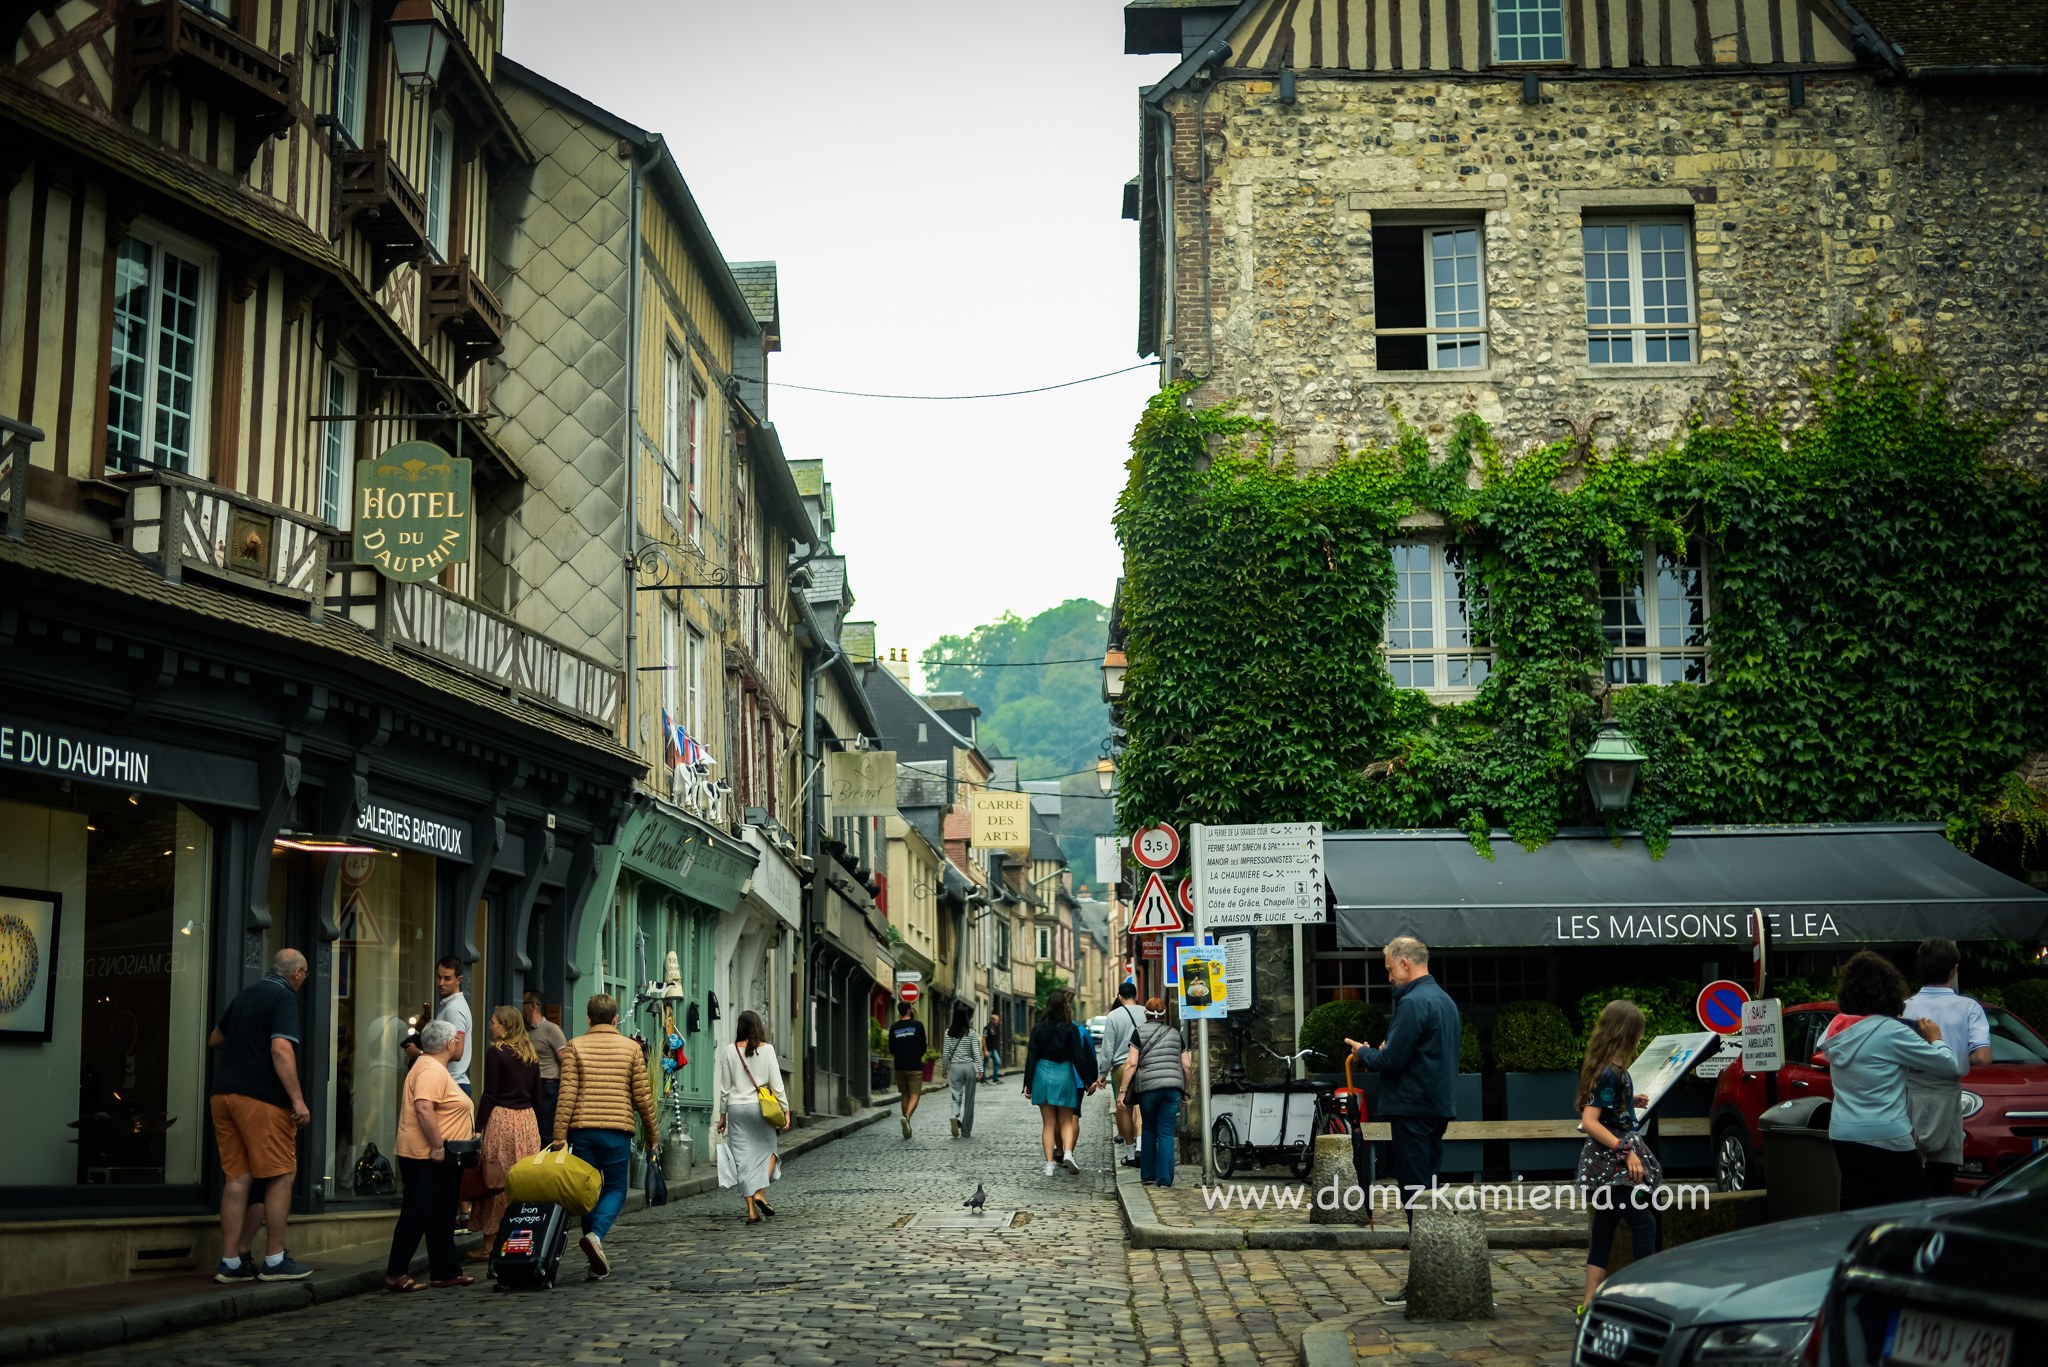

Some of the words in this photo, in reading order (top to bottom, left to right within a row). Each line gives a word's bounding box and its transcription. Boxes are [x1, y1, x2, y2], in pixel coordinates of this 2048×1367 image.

[362, 488, 465, 519] HOTEL
[398, 532, 424, 545] DU
[363, 528, 460, 573] DAUPHIN
[20, 730, 51, 766] DU
[58, 738, 149, 784] DAUPHIN
[977, 797, 1024, 810] CARRÉ
[988, 816, 1014, 826] DES
[357, 804, 411, 841] GALERIES
[412, 818, 462, 855] BARTOUX
[983, 831, 1019, 842] ARTS
[1207, 843, 1225, 852] FERME
[1226, 843, 1241, 852] SAINT
[1262, 842, 1267, 851] &
[1267, 842, 1278, 851] SPA
[1207, 857, 1230, 866] MANOIR
[1240, 855, 1293, 866] IMPRESSIONNISTES
[1210, 871, 1219, 880] LA
[1207, 885, 1231, 895] Musée
[1261, 884, 1286, 893] Boudin
[1208, 899, 1226, 909] Côte
[1227, 899, 1237, 908] de
[1263, 897, 1295, 909] Chapelle
[1209, 914, 1219, 924] LA
[1220, 913, 1251, 923] MAISON
[1265, 912, 1286, 922] LUCIE
[1557, 915, 1600, 939] LES
[1609, 914, 1737, 939] MAISONS
[1790, 913, 1839, 938] LEA
[1751, 1004, 1767, 1020] SAUF
[1748, 1037, 1774, 1049] AMBULANTS
[520, 1202, 538, 1214] bon
